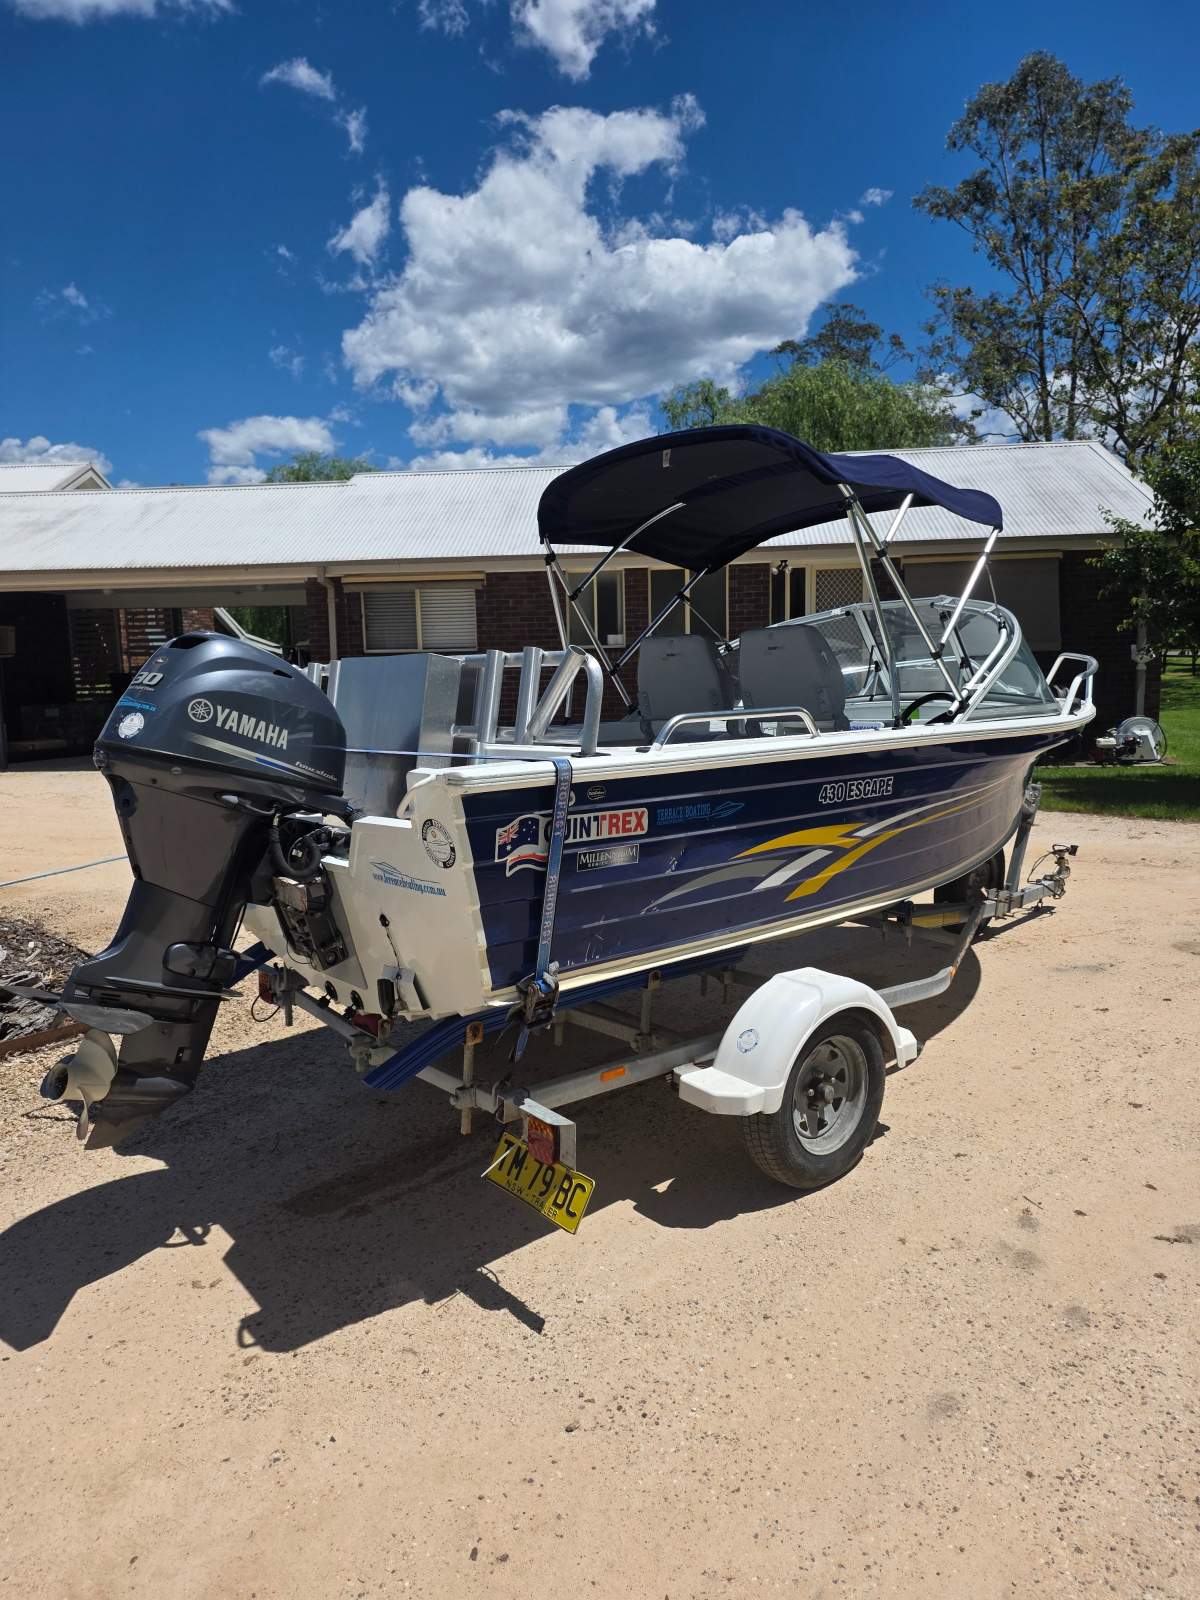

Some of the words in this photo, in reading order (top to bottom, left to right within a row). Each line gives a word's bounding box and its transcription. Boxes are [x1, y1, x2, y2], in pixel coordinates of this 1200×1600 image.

[132, 672, 164, 686] 30
[215, 705, 290, 750] YAMAHA
[819, 783, 845, 804] 430
[846, 776, 894, 801] ESCAPE
[685, 803, 711, 817] BOATING
[505, 1179, 523, 1196] NSW
